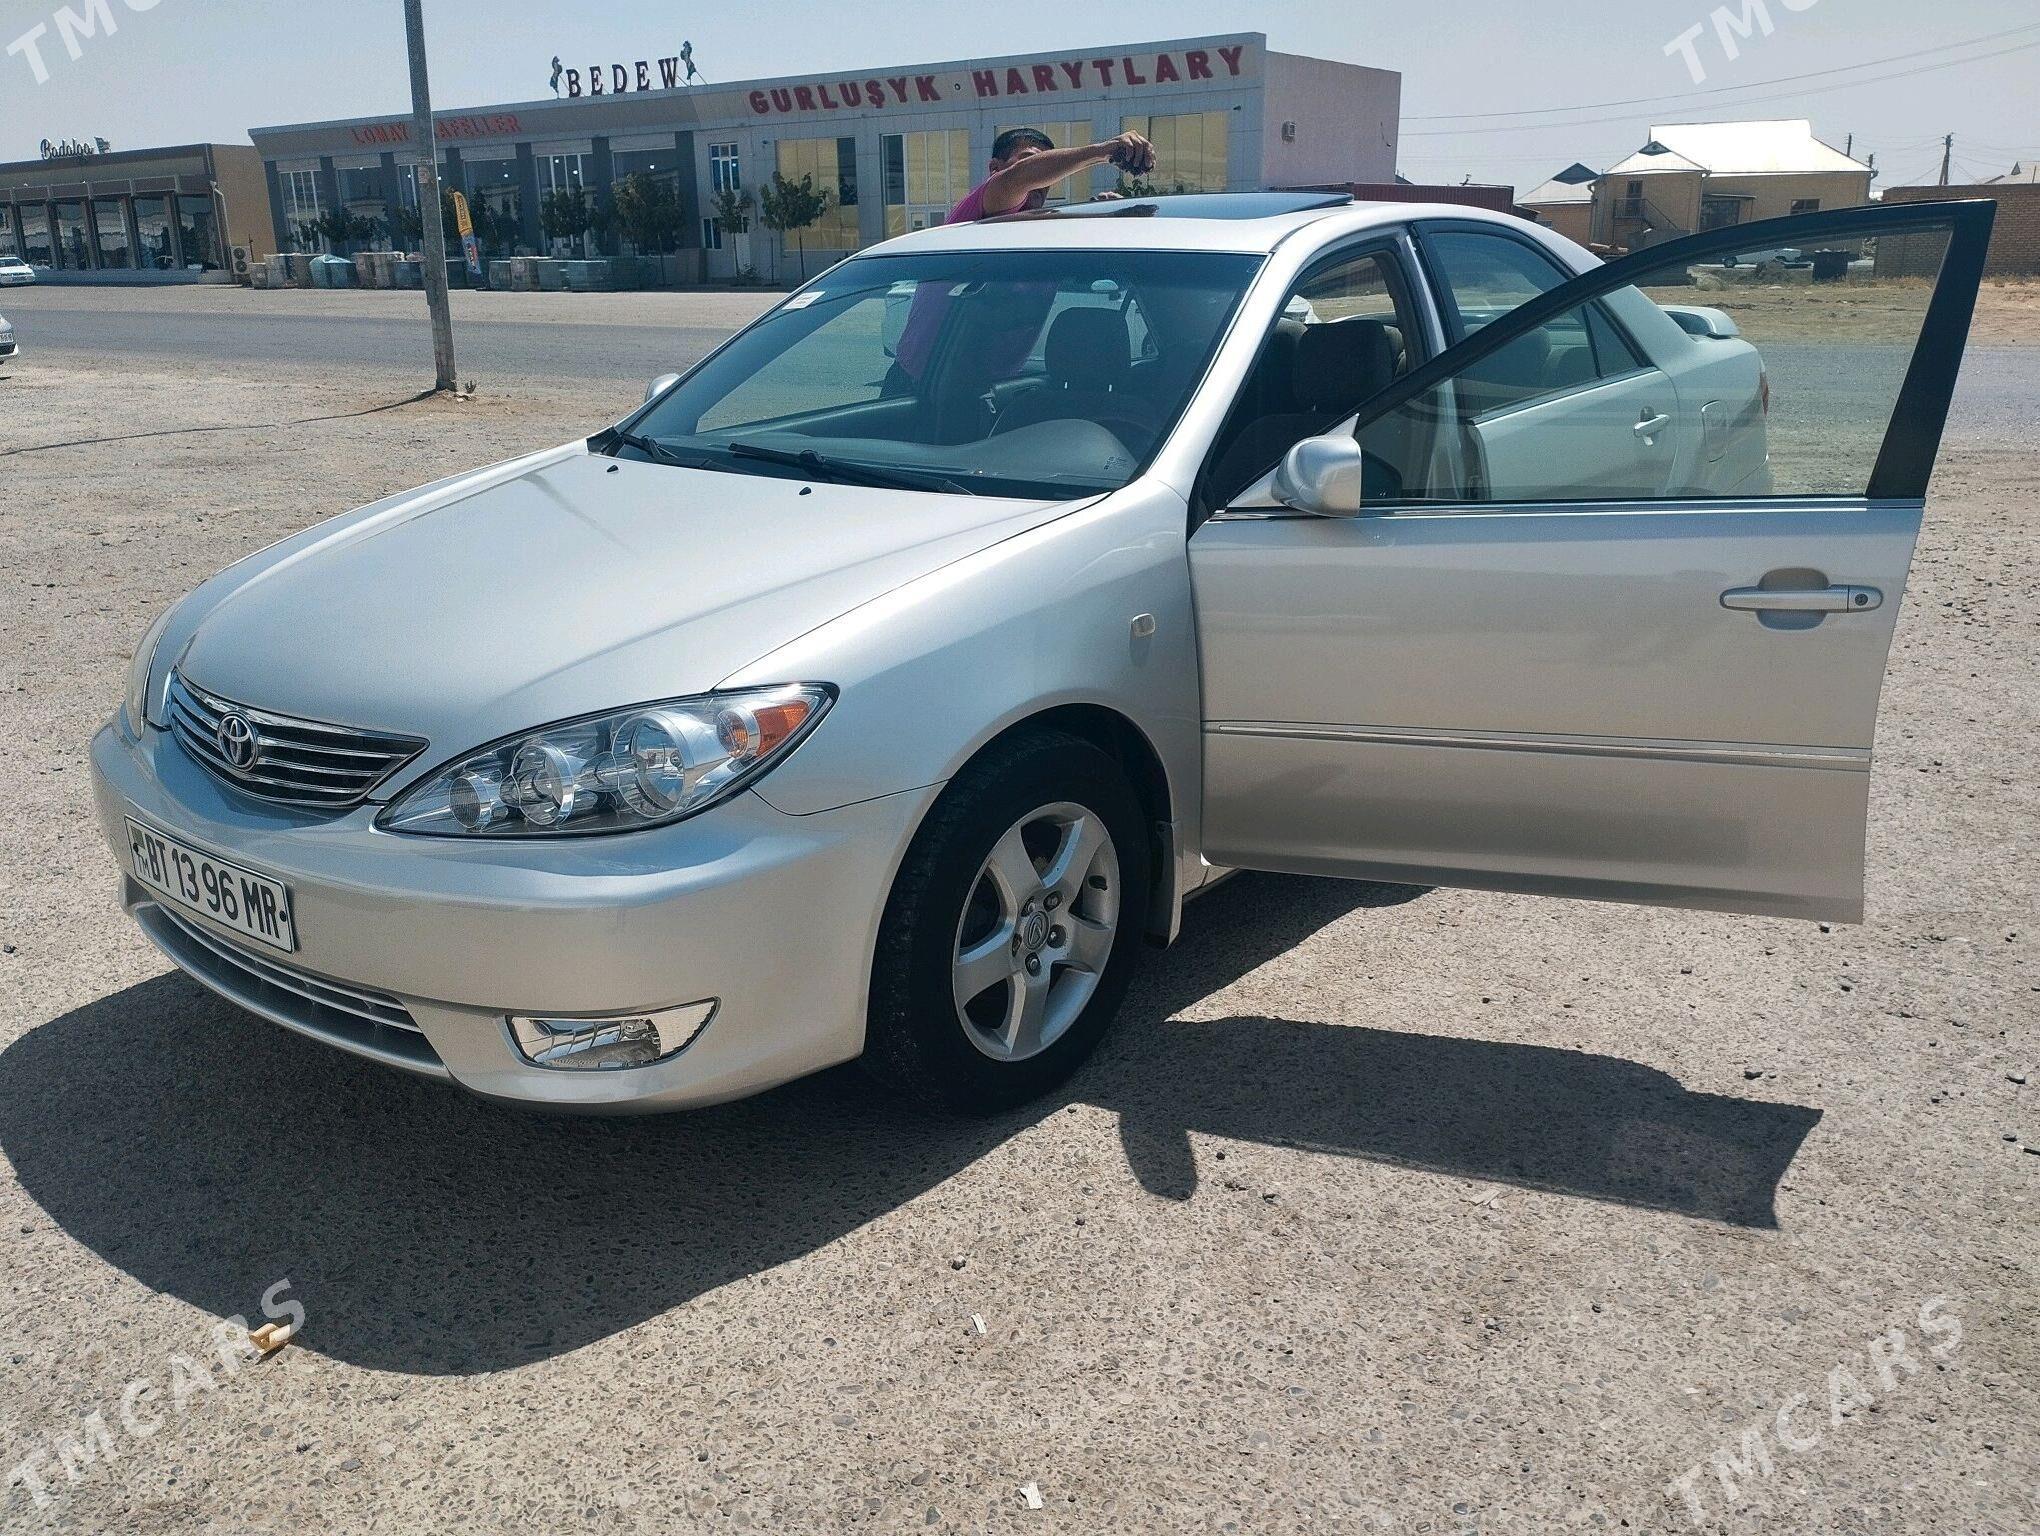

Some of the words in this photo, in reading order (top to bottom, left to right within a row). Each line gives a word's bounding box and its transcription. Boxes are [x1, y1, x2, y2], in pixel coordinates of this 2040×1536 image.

[566, 57, 679, 98] BEDEW
[750, 75, 941, 115] GURLUŞYK
[972, 46, 1243, 98] HARYTLARY
[145, 834, 169, 888] BT
[241, 878, 280, 939] MR
